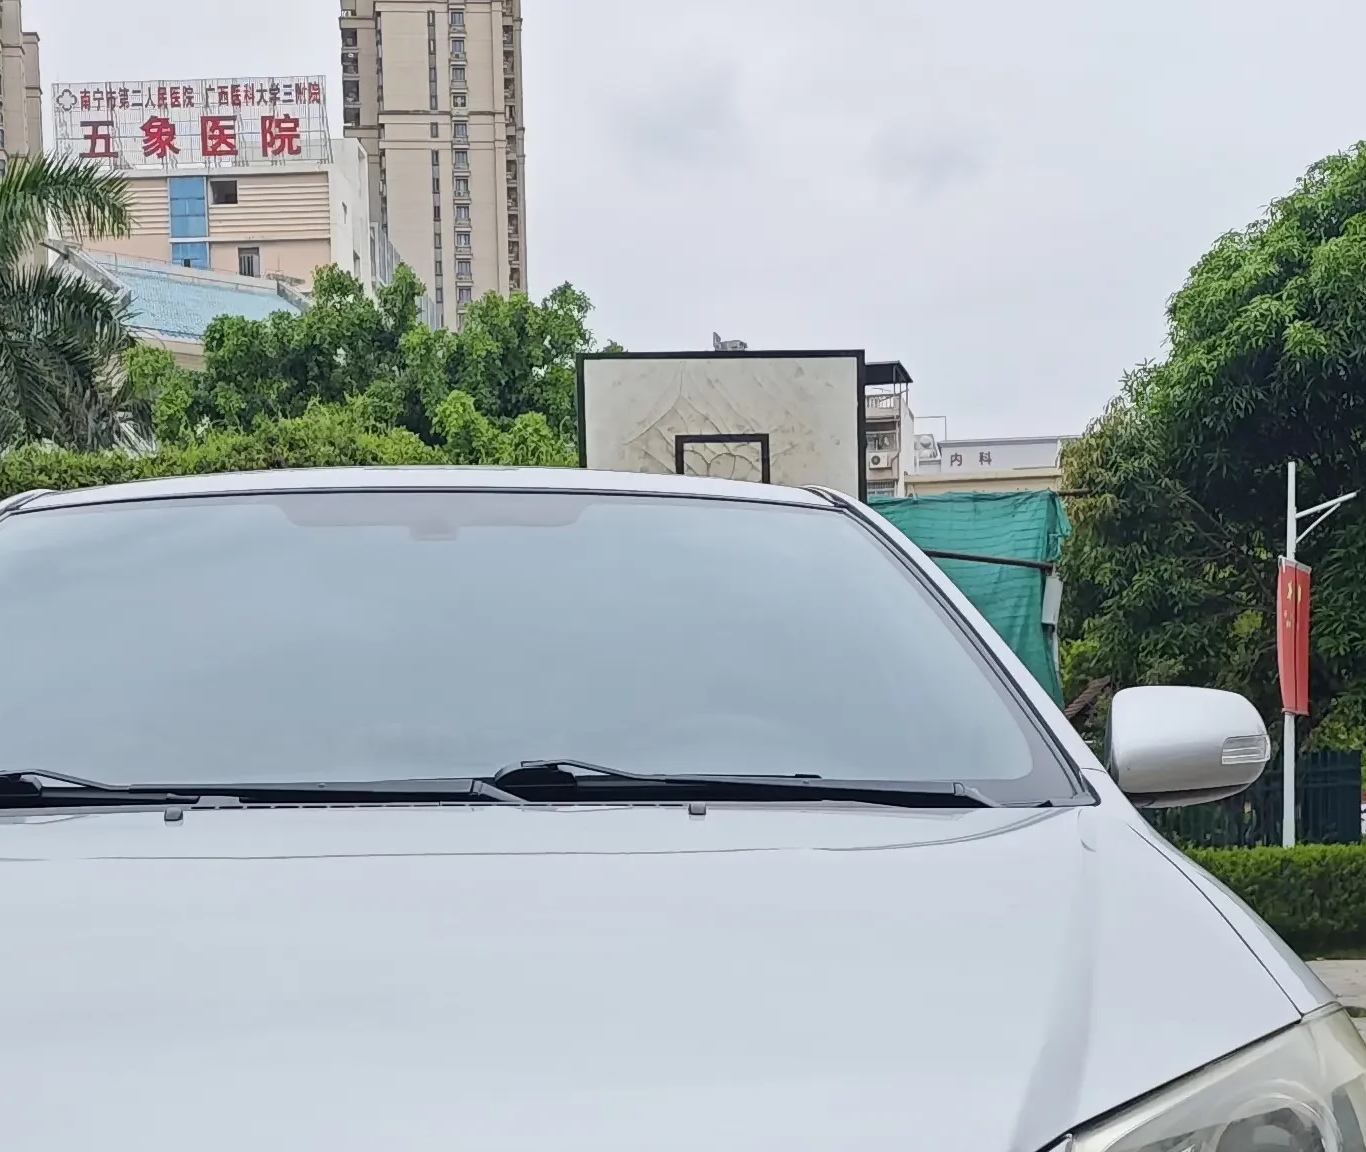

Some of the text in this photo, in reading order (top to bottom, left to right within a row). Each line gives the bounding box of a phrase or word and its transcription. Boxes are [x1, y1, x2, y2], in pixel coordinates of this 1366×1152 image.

[79, 81, 321, 111] 南宁市第二人民医院 广西医科大学三附院
[79, 113, 302, 159] 五象医院
[949, 450, 993, 467] 内科
